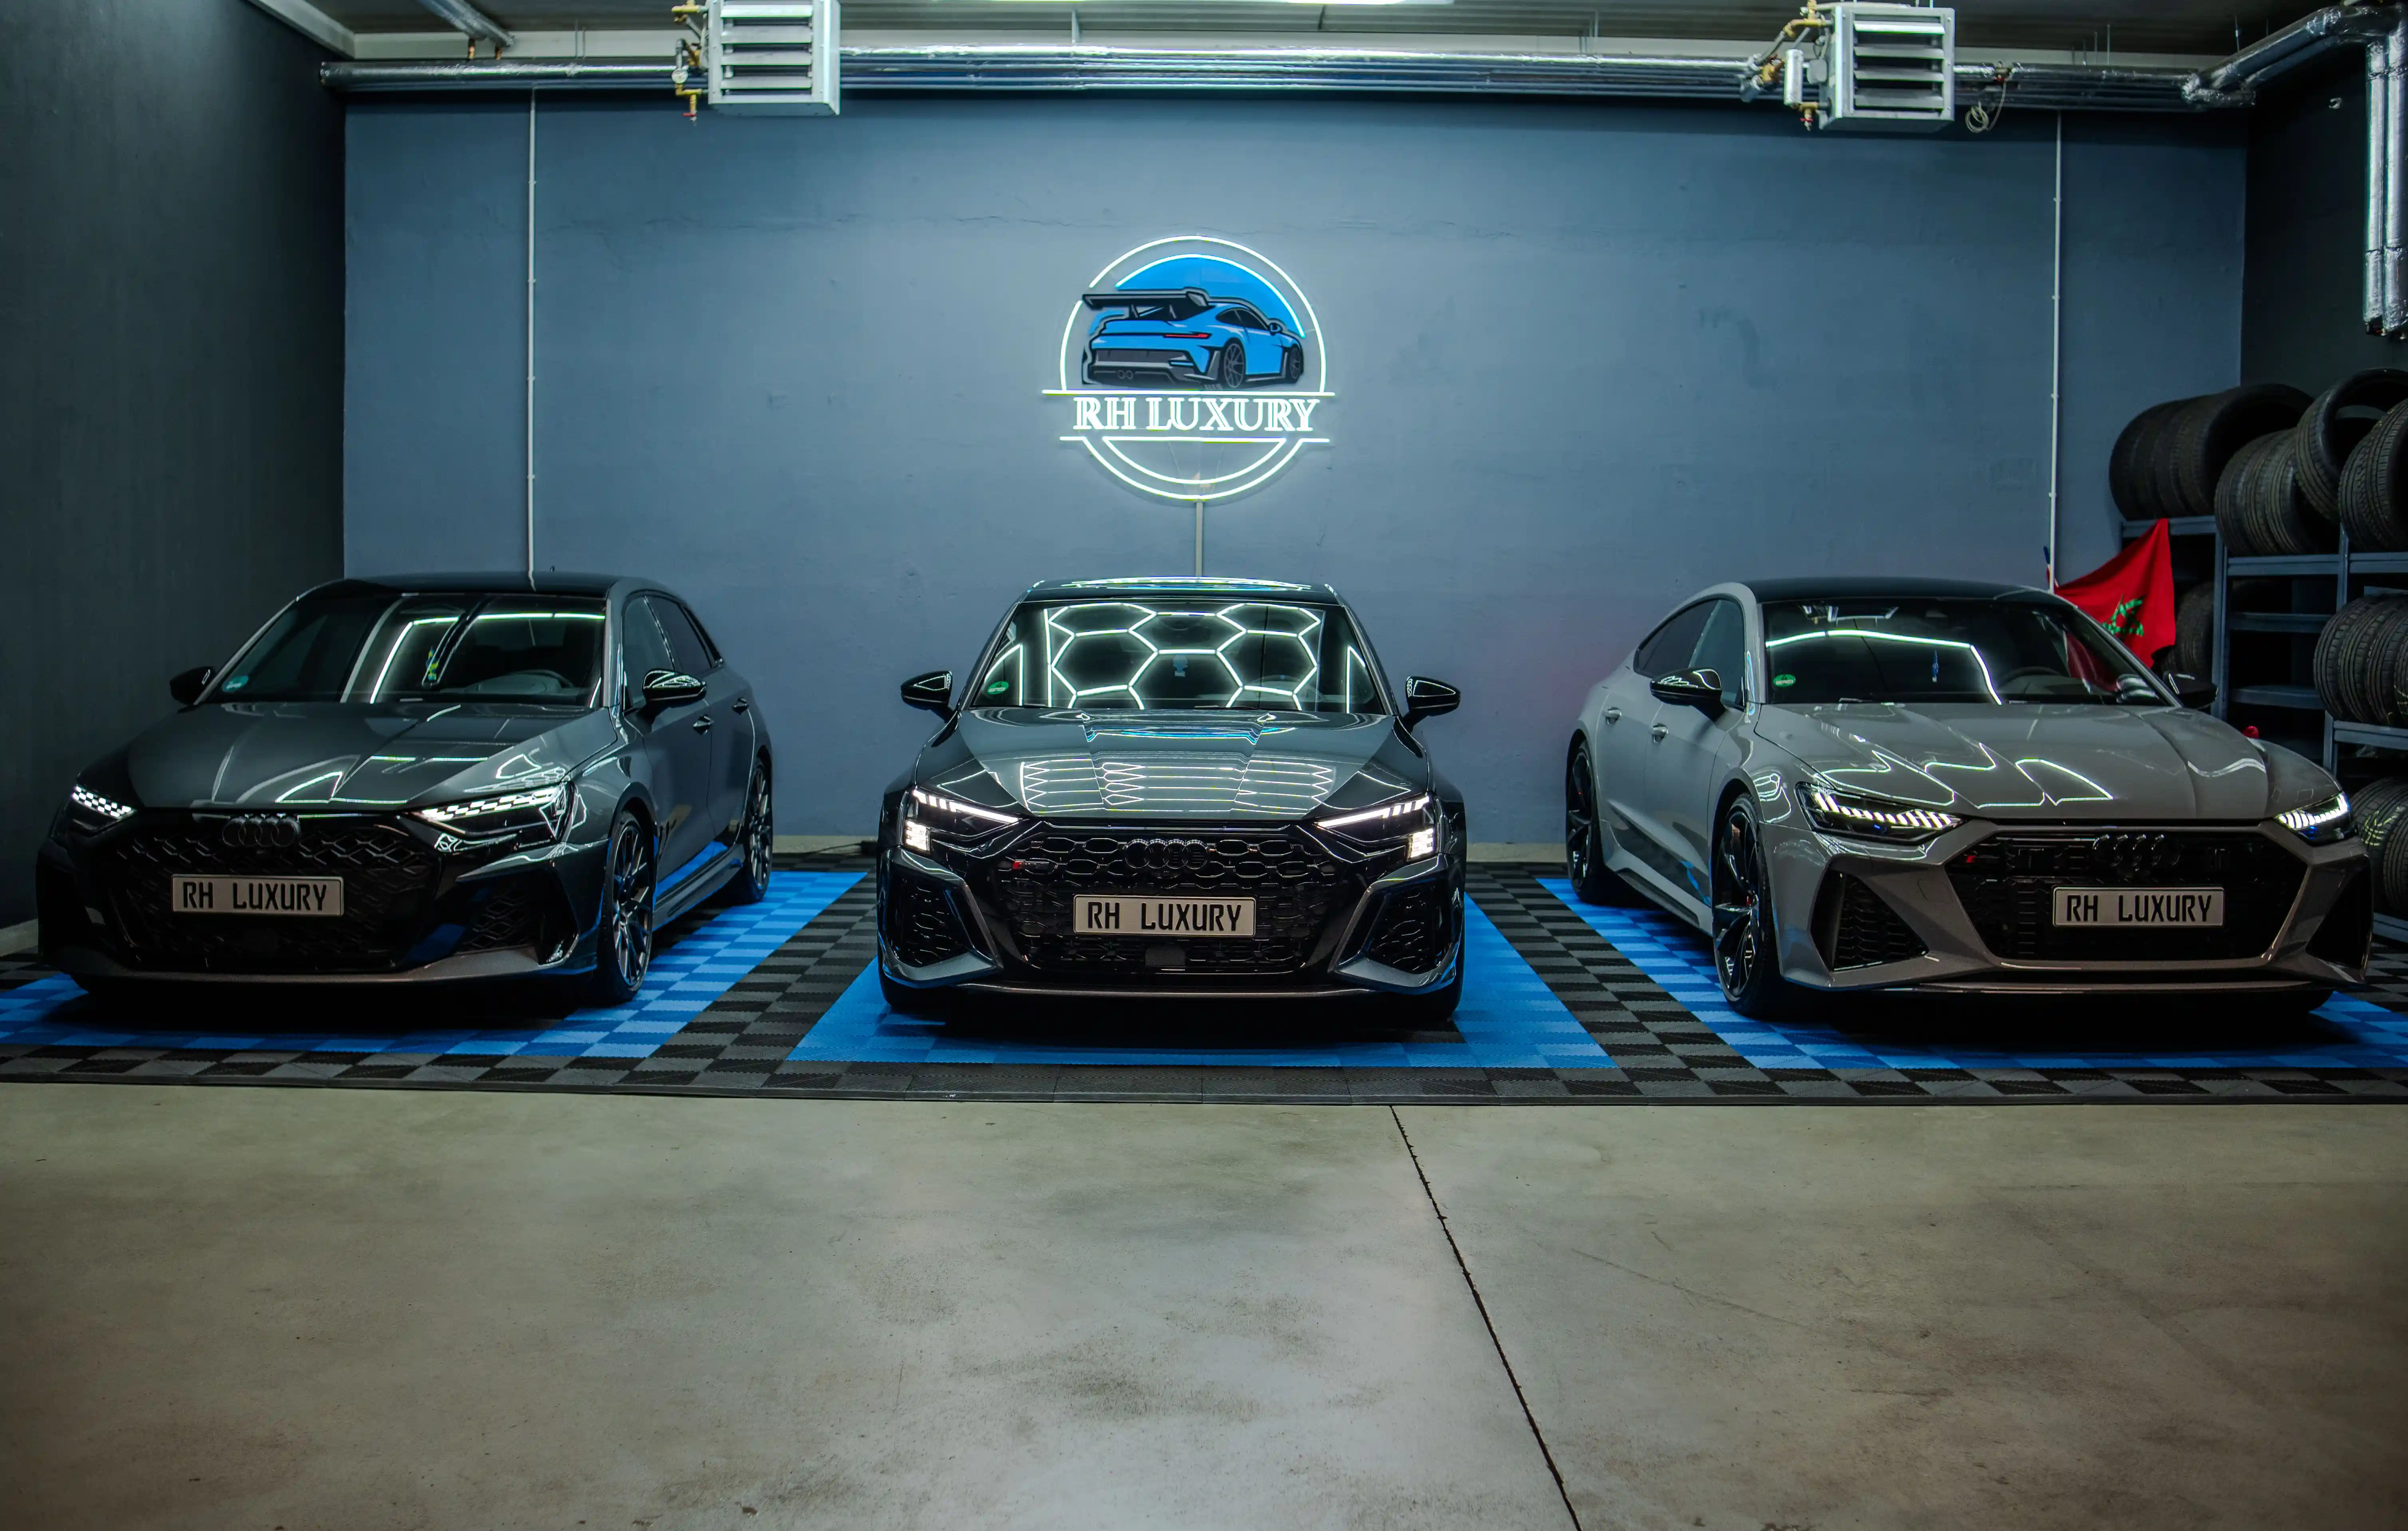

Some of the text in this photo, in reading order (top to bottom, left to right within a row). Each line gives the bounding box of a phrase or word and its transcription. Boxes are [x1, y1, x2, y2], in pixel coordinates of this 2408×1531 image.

[1073, 397, 1320, 431] RH LUXURY
[183, 881, 327, 911] RH LUXURY
[2066, 894, 2212, 922] RH LUXURY
[1088, 901, 1242, 931] RH LUXURY
